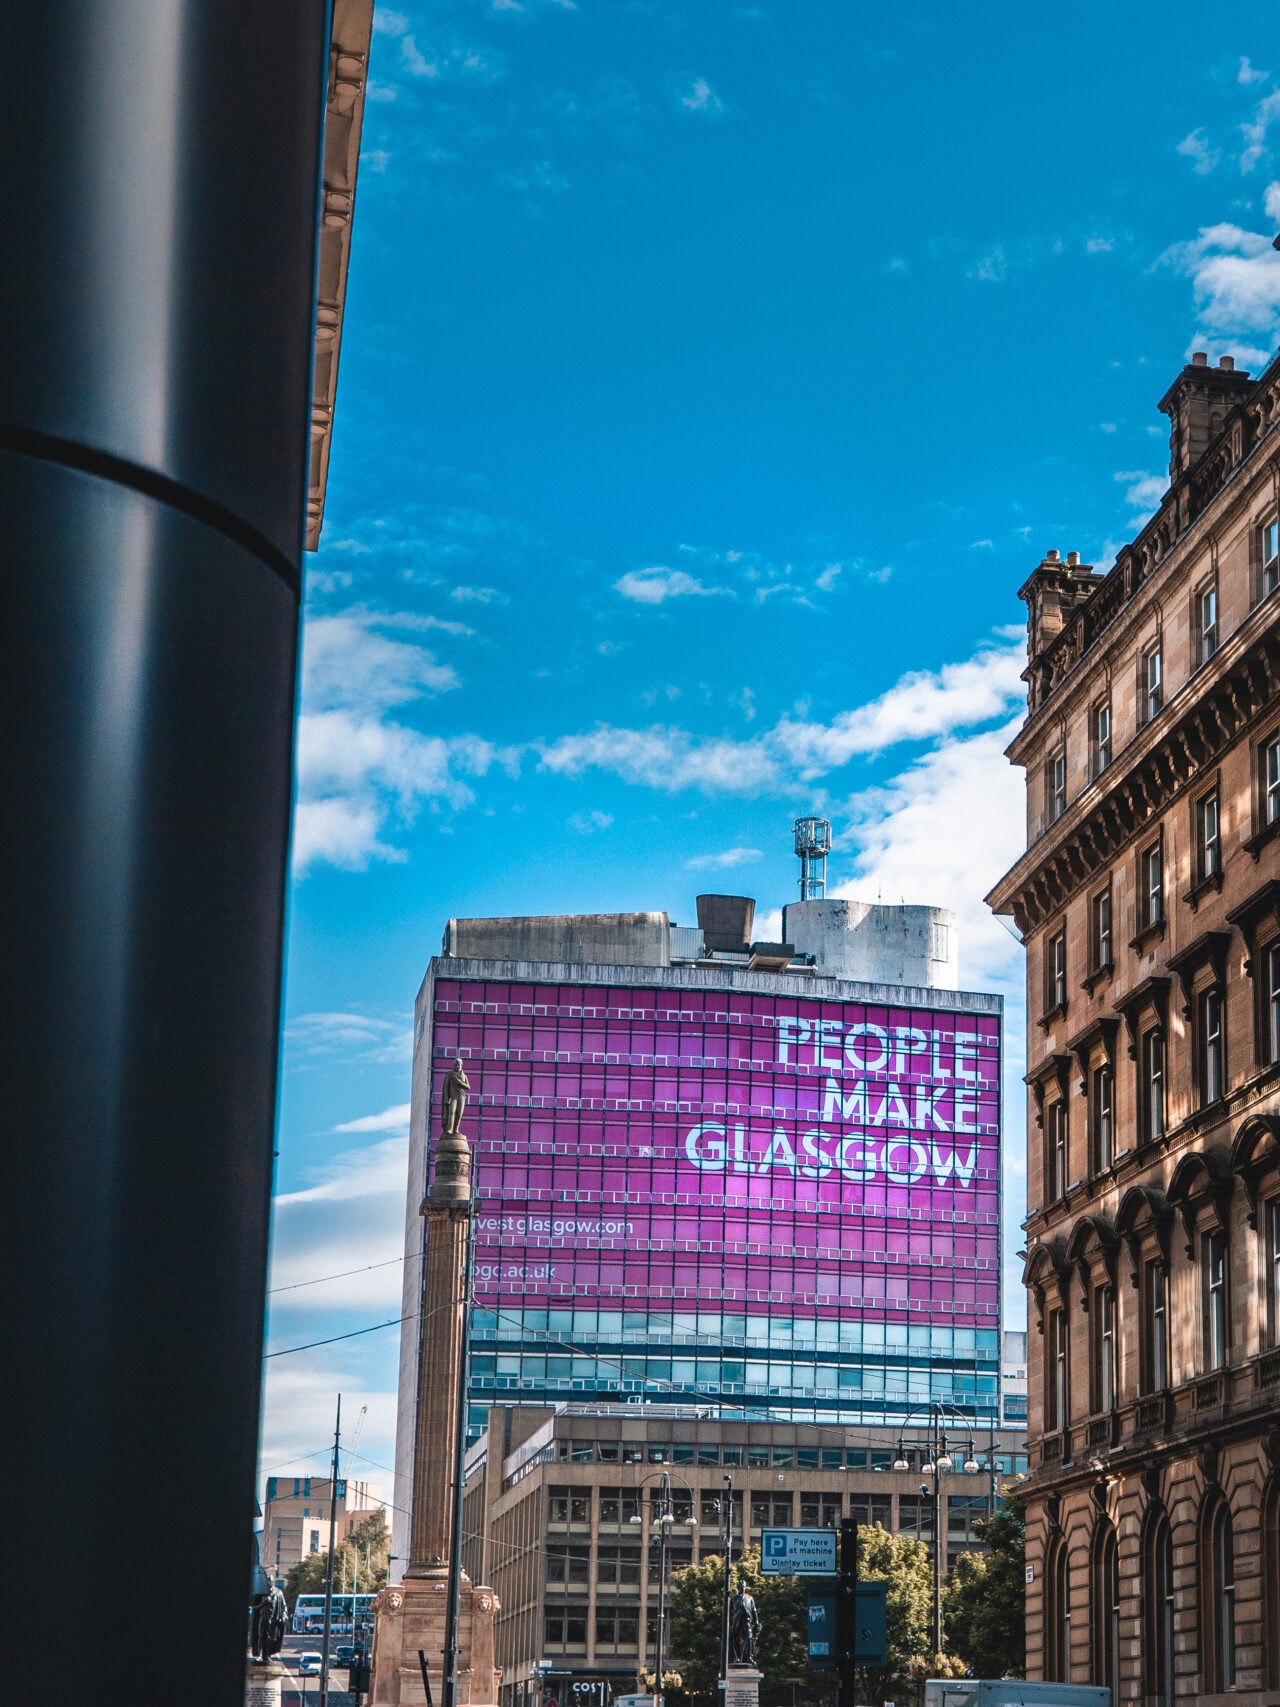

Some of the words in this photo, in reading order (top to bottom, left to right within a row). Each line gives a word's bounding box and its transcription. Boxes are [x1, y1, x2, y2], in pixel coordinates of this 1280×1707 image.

[777, 1016, 983, 1081] PEOPLE
[823, 1078, 982, 1134] MAKE
[685, 1121, 982, 1188] GLASGOW
[770, 1537, 784, 1555] P
[793, 1538, 808, 1547] Pay
[799, 1547, 833, 1555] machine
[803, 1559, 827, 1567] ticket
